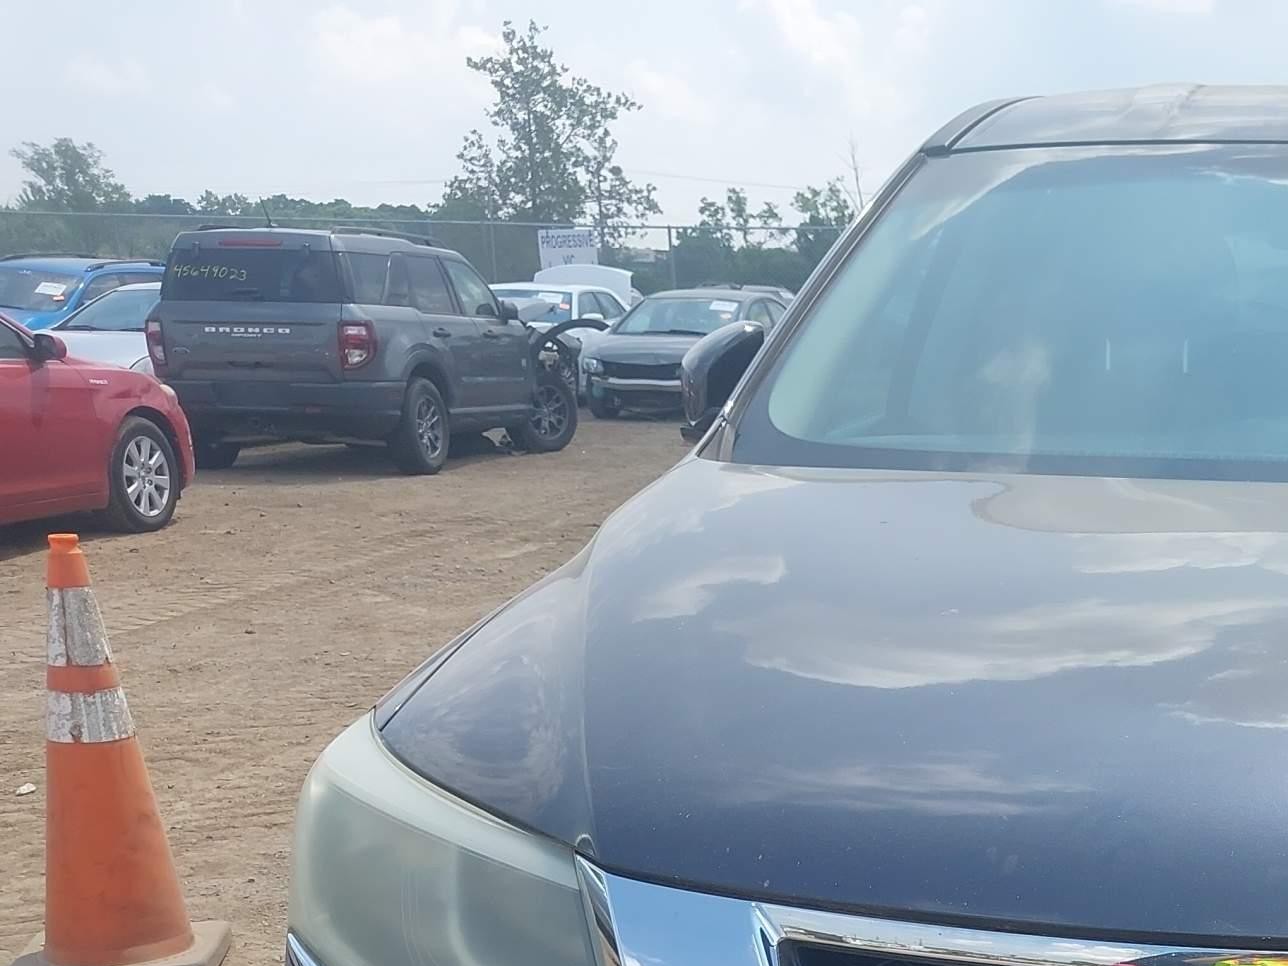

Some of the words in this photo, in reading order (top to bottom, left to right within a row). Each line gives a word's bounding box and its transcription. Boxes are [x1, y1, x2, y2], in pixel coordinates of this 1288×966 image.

[541, 232, 596, 249] PROGRESSIVE
[174, 264, 247, 281] 45649023
[204, 326, 290, 334] BRONCO
